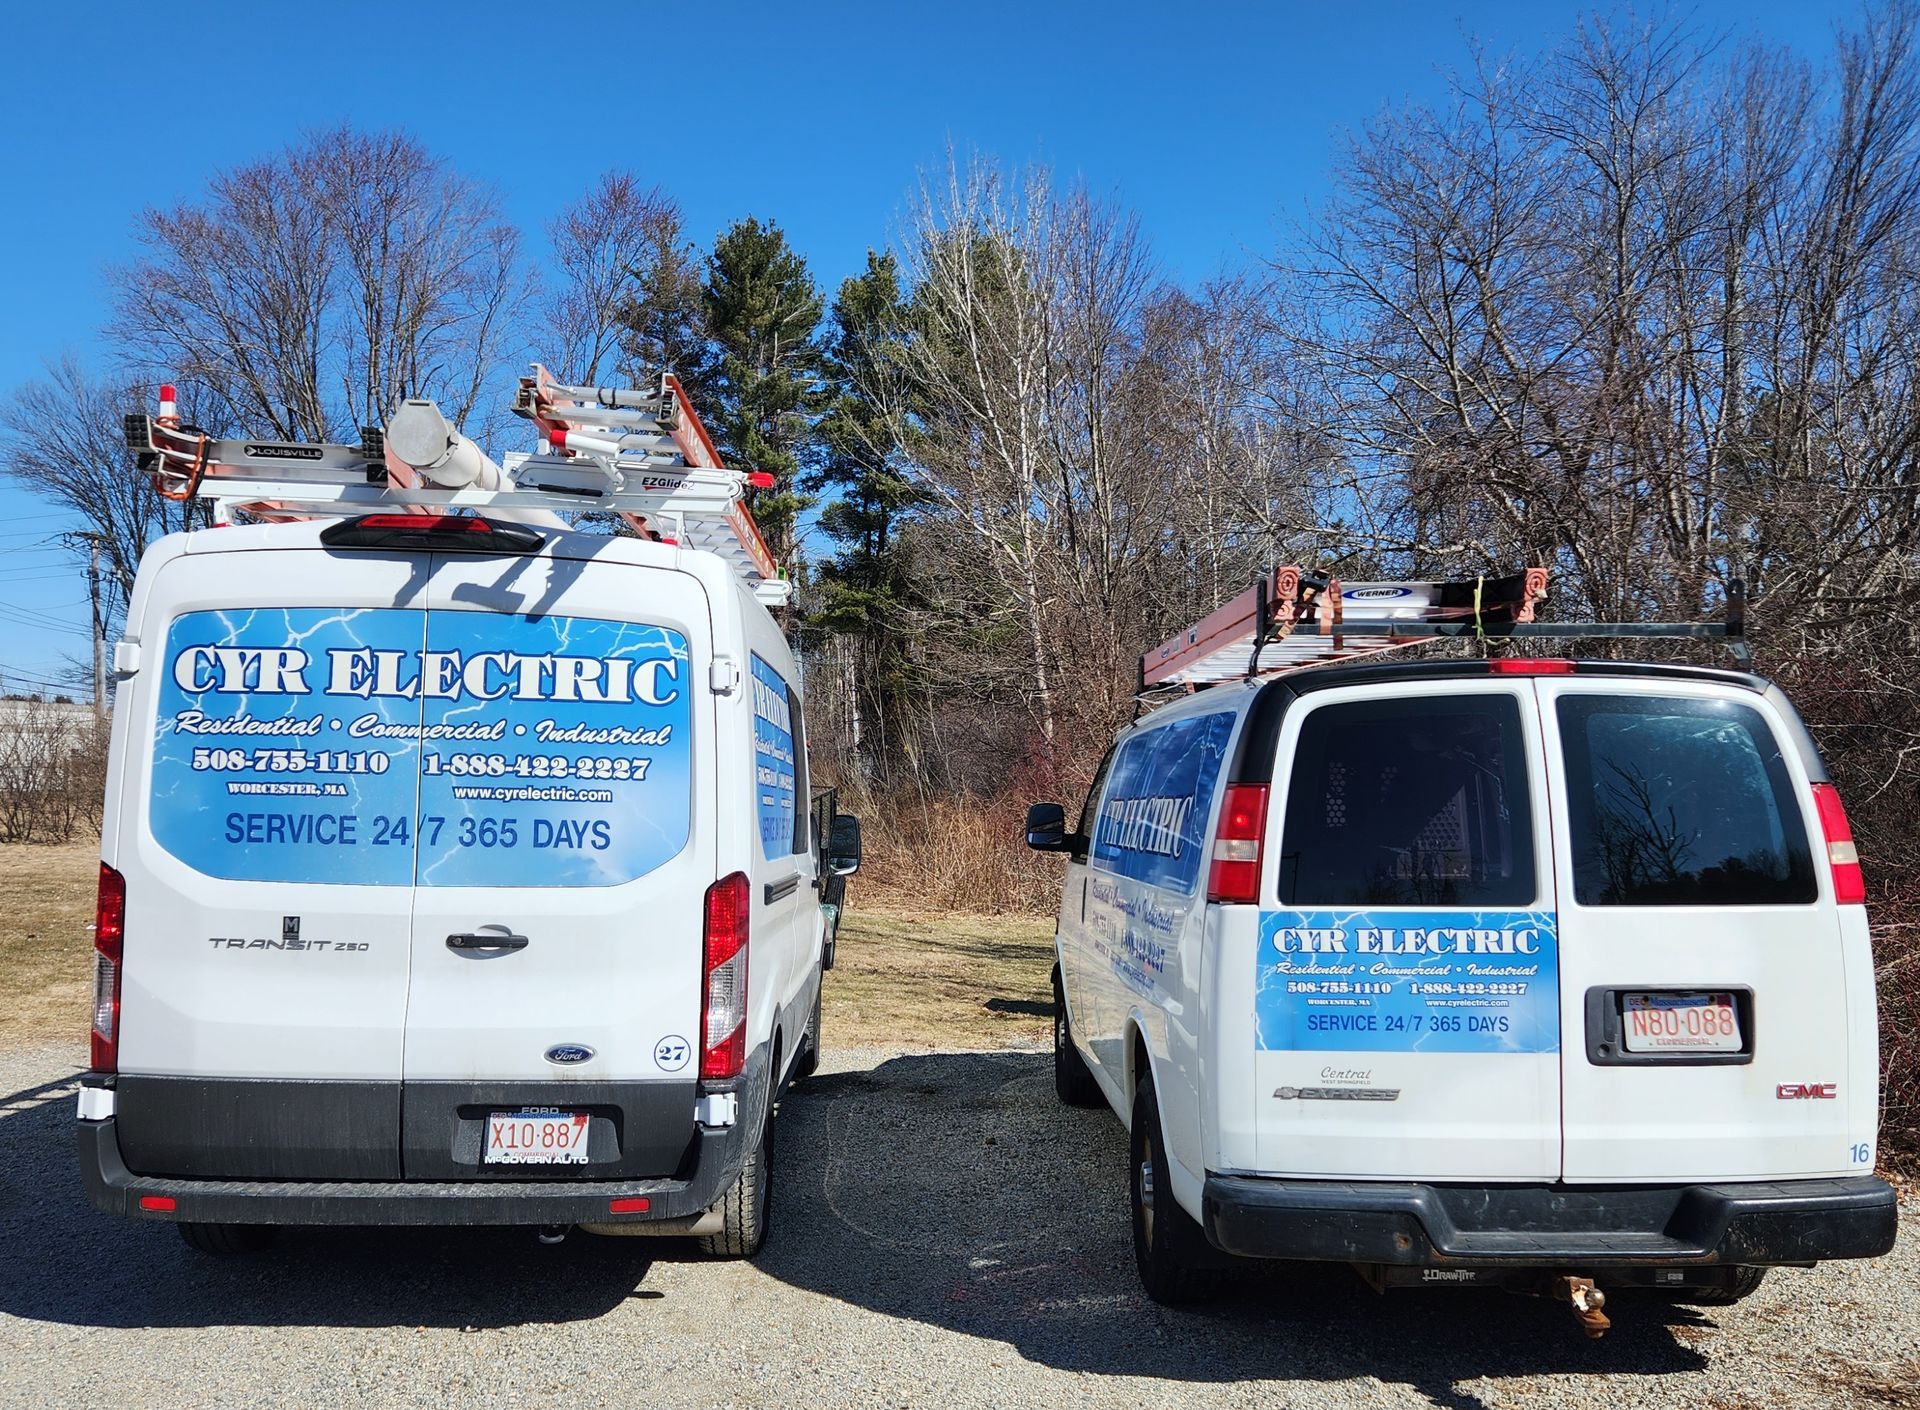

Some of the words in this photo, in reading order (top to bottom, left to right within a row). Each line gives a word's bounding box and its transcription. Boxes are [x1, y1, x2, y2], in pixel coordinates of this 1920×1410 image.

[257, 447, 322, 457] LOUISVILLE
[642, 477, 694, 490] EZGlide2
[1357, 590, 1398, 598] WERNER
[172, 642, 312, 696] CYR
[324, 645, 680, 706] ELECTRIC
[175, 709, 323, 736] Residential
[348, 713, 507, 740] Commercial
[534, 718, 673, 746] Industrial
[191, 746, 390, 774] 508-755-1110
[423, 752, 652, 780] 1-888-422-2227
[227, 782, 322, 797] WORCESTER,
[323, 784, 348, 796] MA
[453, 785, 613, 803] www.cyrelectric.com
[225, 812, 357, 845] SERVICE
[372, 814, 445, 848] 24/7
[458, 817, 518, 848] 365
[533, 819, 611, 850] DAYS
[1118, 793, 1194, 859] ELECTRIC
[285, 917, 298, 932] M
[209, 938, 332, 950] TRANSIT
[334, 943, 369, 951] 250
[1272, 927, 1348, 953] CYR
[1355, 927, 1540, 955] ELECTRIC
[1276, 961, 1356, 975] Residential
[1369, 962, 1452, 976] Commercial
[1466, 963, 1538, 976] Industrial
[1287, 980, 1392, 994] 508-755-1110
[1409, 981, 1528, 995] 1-888-422-2227
[1426, 998, 1509, 1008] www.cyrelectric.com
[1307, 1015, 1377, 1031] SERVICE
[1384, 1015, 1422, 1032] 24/7
[1429, 1016, 1461, 1032] 365
[1468, 1016, 1509, 1032] DAYS
[554, 1048, 582, 1060] Ford
[659, 1046, 685, 1060] 27
[1321, 1066, 1372, 1079] Central
[1298, 1088, 1400, 1101] EXPRESS
[1776, 1082, 1837, 1099] GMC
[521, 1107, 559, 1115] FORD
[484, 1156, 553, 1164] McGOVERN
[553, 1156, 589, 1164] AUTO
[1850, 1143, 1869, 1163] 16
